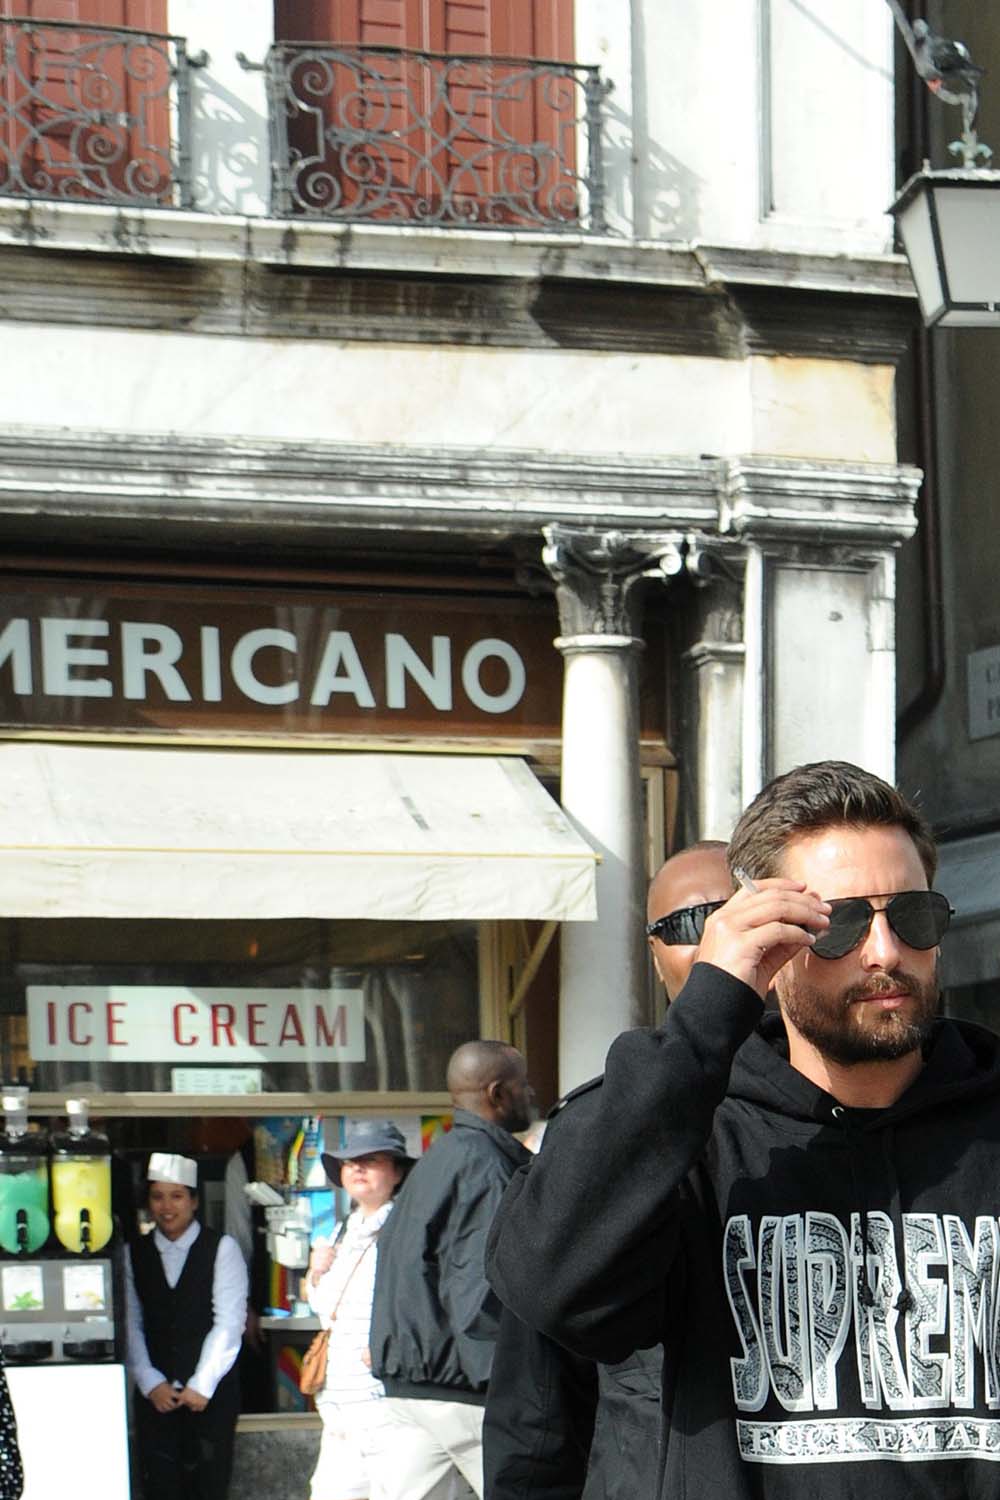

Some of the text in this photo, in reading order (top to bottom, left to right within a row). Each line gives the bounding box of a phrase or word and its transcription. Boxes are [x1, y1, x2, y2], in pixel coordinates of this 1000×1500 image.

[46, 1001, 348, 1047] ICE CREAM
[875, 1423, 940, 1452] EM
